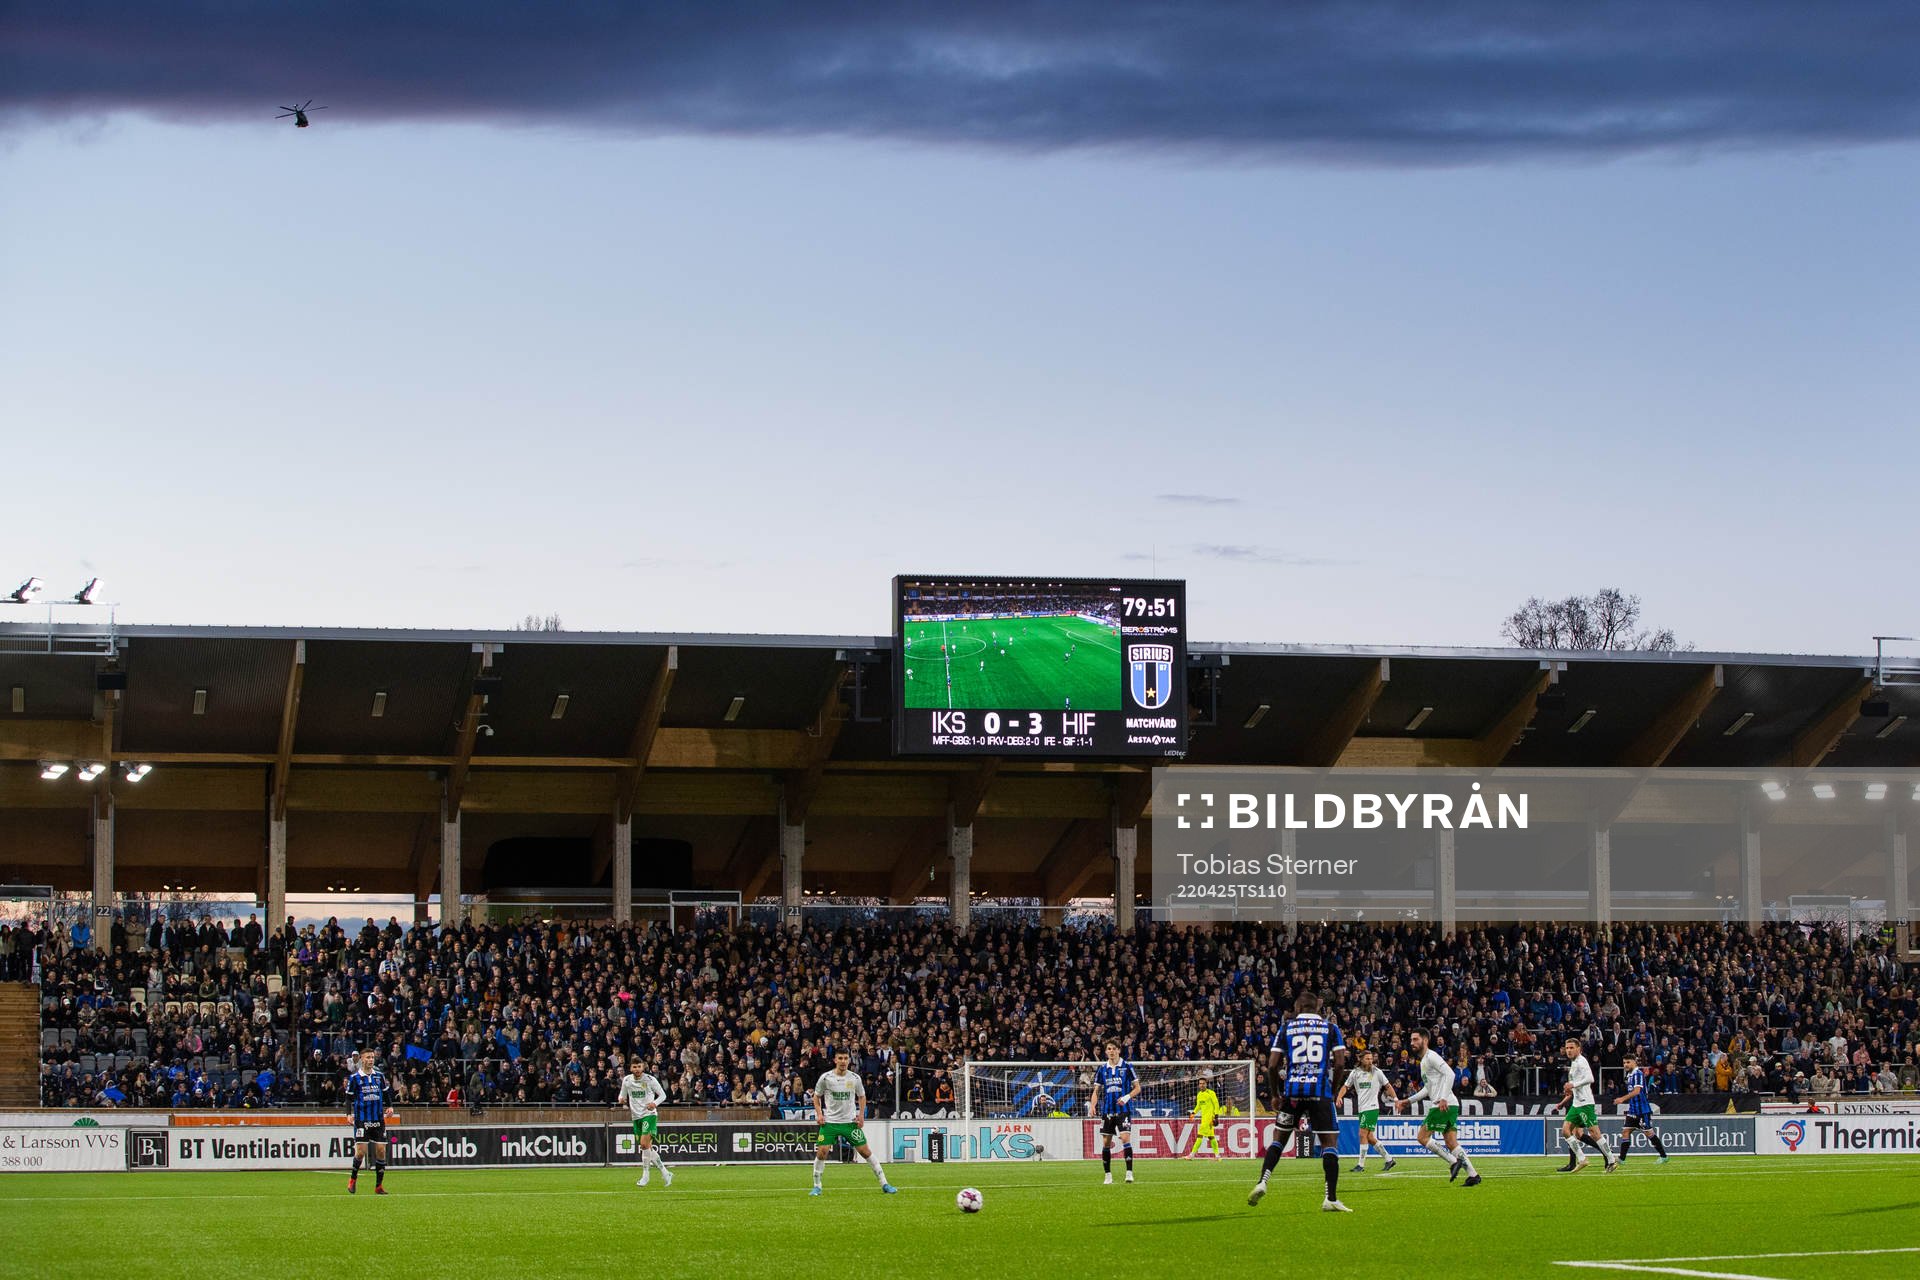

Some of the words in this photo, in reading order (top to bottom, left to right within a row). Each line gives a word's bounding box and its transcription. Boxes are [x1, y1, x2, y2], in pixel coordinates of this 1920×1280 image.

[1122, 597, 1175, 617] 79:51
[1132, 647, 1170, 661] SIRIUS
[932, 711, 966, 734] IKS
[984, 712, 1001, 735] 0
[1028, 712, 1043, 735] 3
[1062, 712, 1096, 735] HIF
[1128, 735, 1152, 743] ÅRSTA
[1161, 736, 1177, 744] TAK
[96, 905, 111, 917] 22
[787, 906, 801, 917] 21
[1291, 1034, 1324, 1064] 26
[1844, 1104, 1890, 1114] SVENSK
[996, 1124, 1032, 1133] JÄRN
[3, 1136, 15, 1149] &
[21, 1134, 80, 1149] Larsson
[86, 1134, 119, 1149] VVS
[501, 1134, 587, 1157] inkClub
[637, 1133, 718, 1144] NICKERI
[180, 1138, 205, 1159] BT
[212, 1138, 321, 1159] Ventilation
[391, 1136, 478, 1159] inkClub
[23, 1155, 43, 1167] 000
